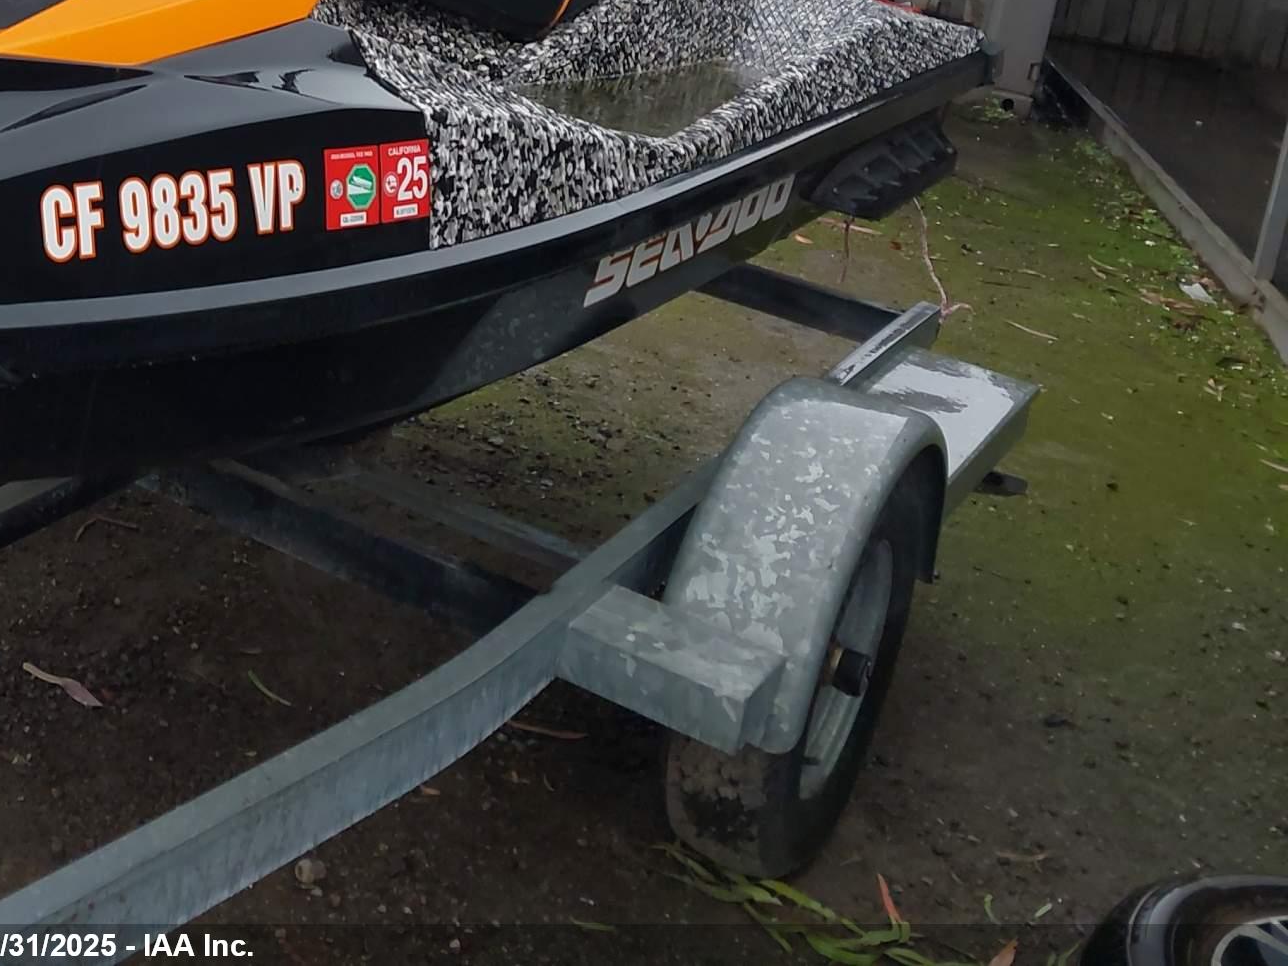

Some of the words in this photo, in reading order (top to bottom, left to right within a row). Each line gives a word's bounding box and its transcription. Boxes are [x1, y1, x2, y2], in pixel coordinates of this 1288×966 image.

[388, 144, 421, 156] CALIFORNIA
[396, 155, 428, 201] 25
[40, 181, 104, 263] CF
[119, 168, 238, 254] 9835
[247, 159, 306, 235] VP
